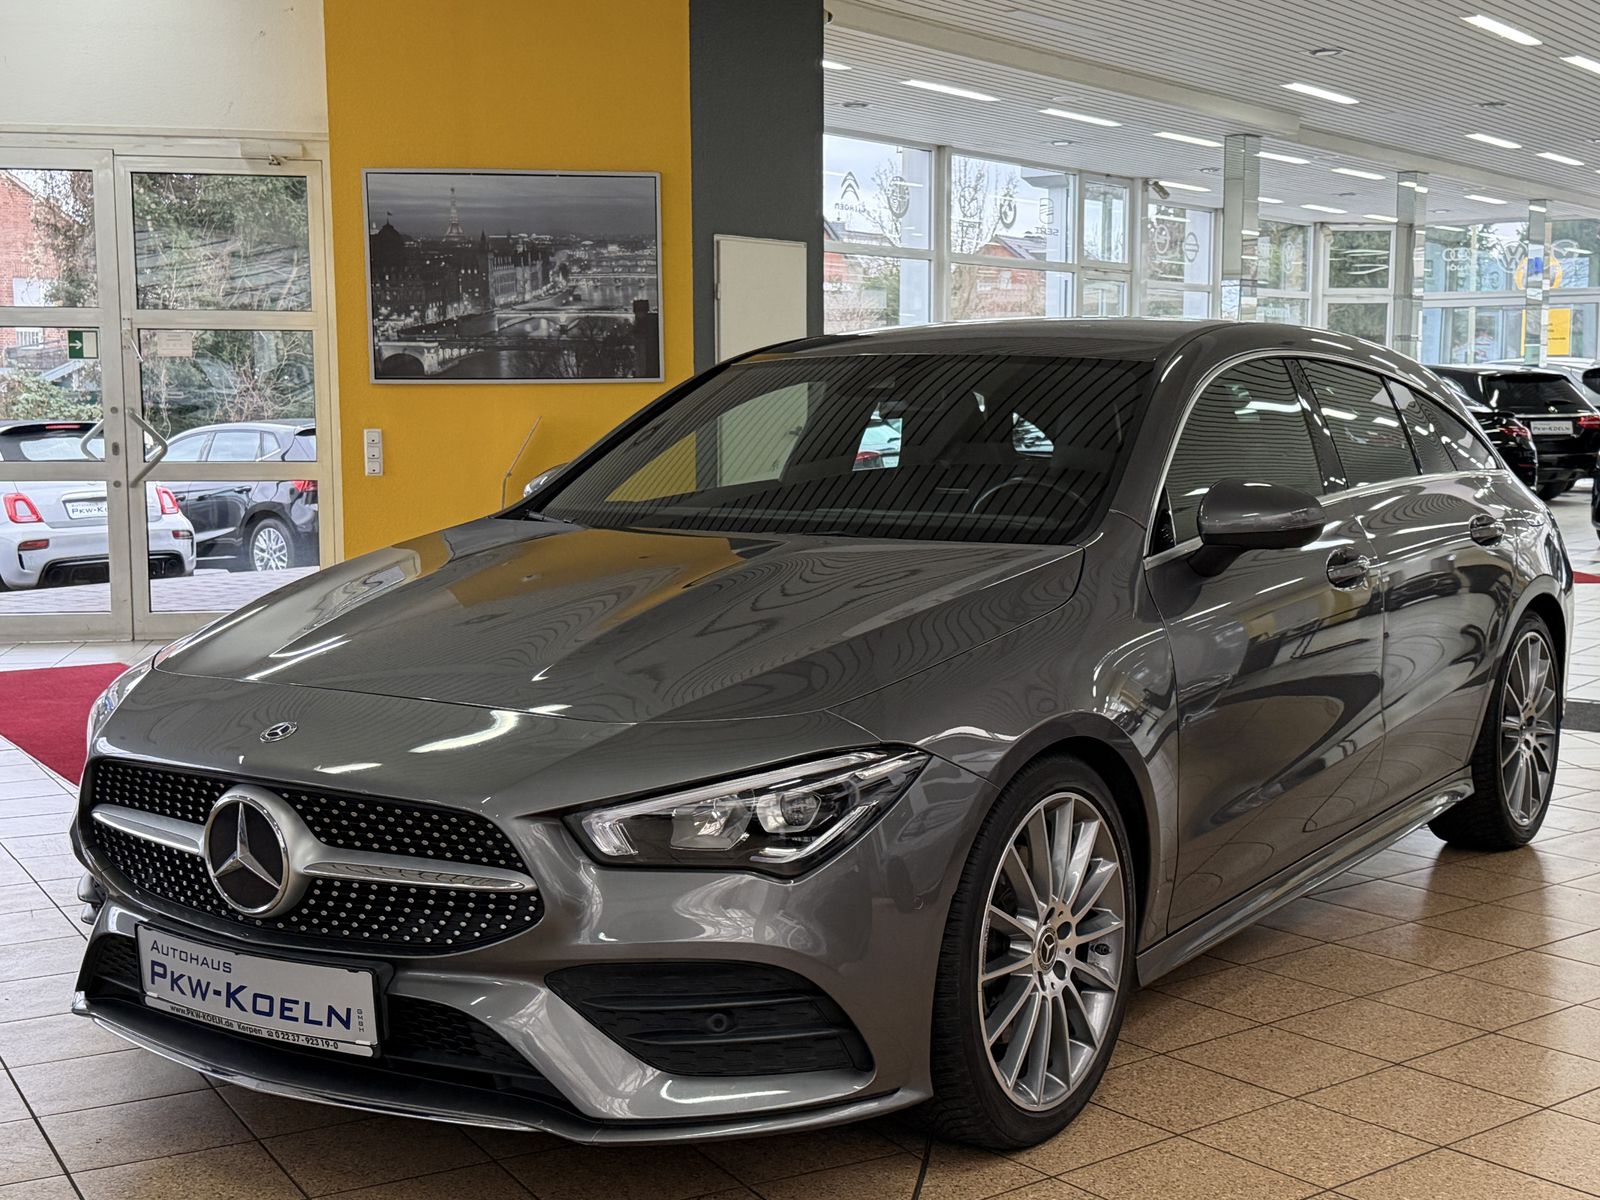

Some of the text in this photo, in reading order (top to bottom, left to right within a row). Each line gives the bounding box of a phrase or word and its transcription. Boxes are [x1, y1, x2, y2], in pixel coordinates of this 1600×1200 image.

[72, 506, 107, 514] PKW-K
[150, 939, 232, 974] AUTOHAUS
[150, 959, 352, 1031] PKW-KOELN
[169, 1004, 234, 1029] www.PKW-KOELN.de
[237, 1021, 263, 1036] Kerpen
